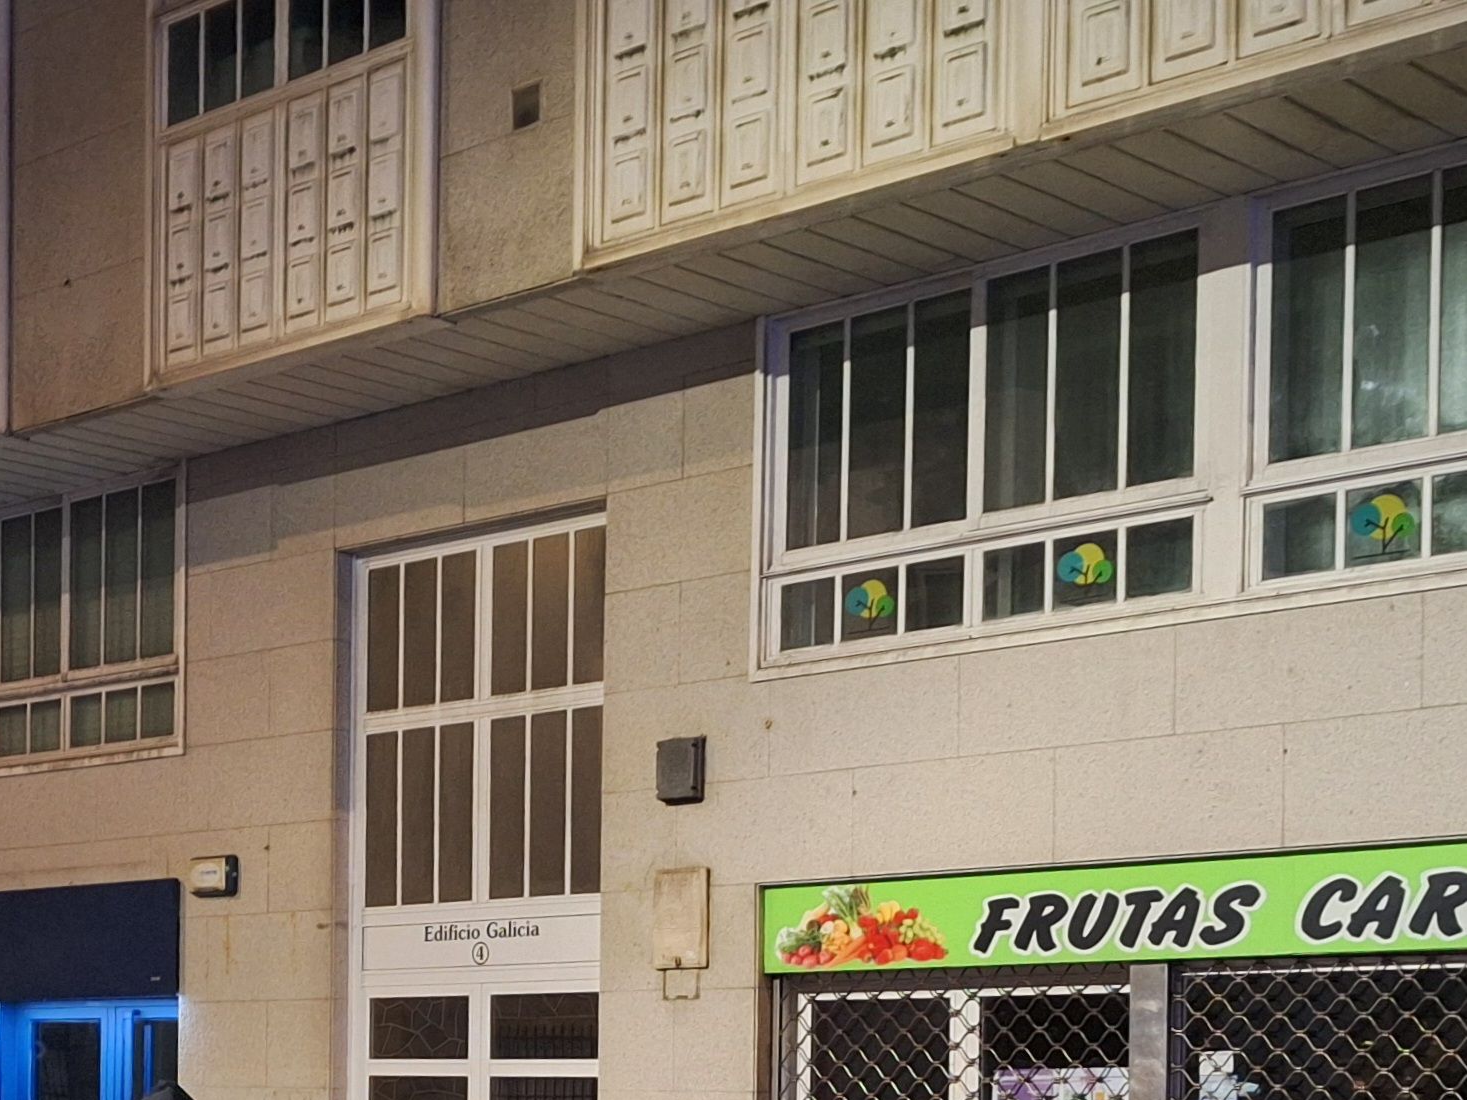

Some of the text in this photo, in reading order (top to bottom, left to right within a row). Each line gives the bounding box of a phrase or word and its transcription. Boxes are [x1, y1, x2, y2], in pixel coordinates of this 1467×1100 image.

[424, 920, 540, 942] Edificio Galicia
[972, 871, 1467, 954] FRUTAS CAR
